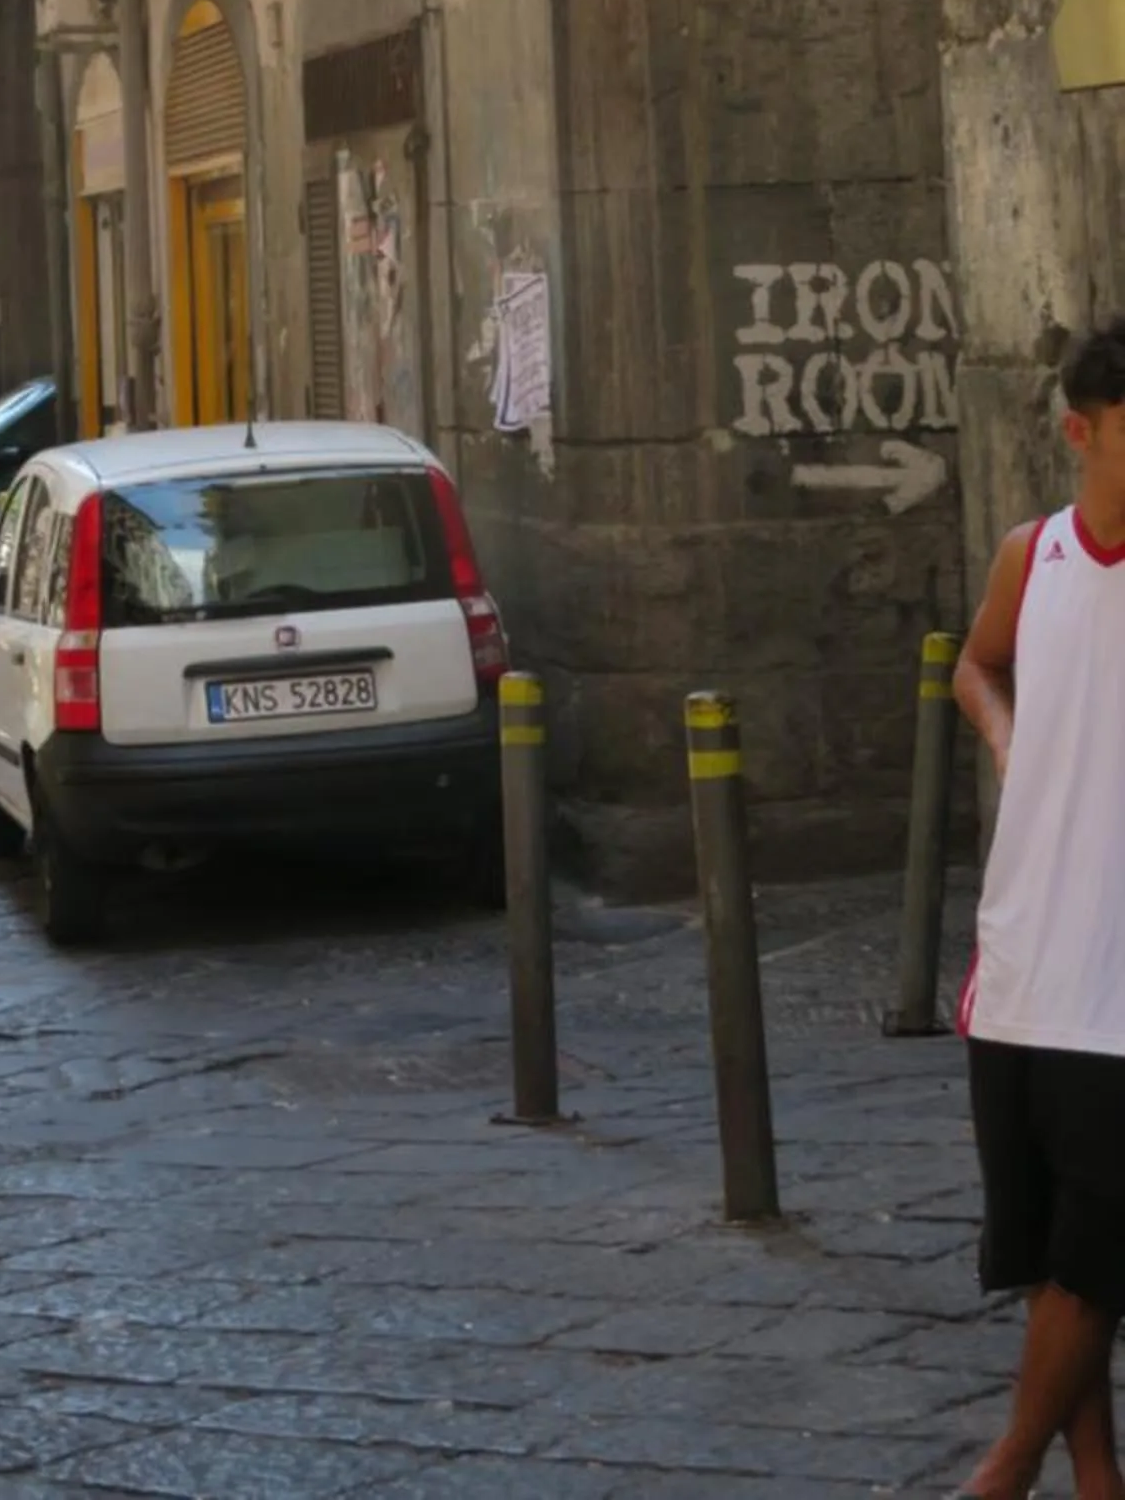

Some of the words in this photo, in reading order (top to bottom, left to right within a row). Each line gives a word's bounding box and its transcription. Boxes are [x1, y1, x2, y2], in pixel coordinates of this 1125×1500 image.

[732, 258, 959, 345] IRON
[224, 685, 279, 715] KNS
[290, 676, 372, 710] 52828
